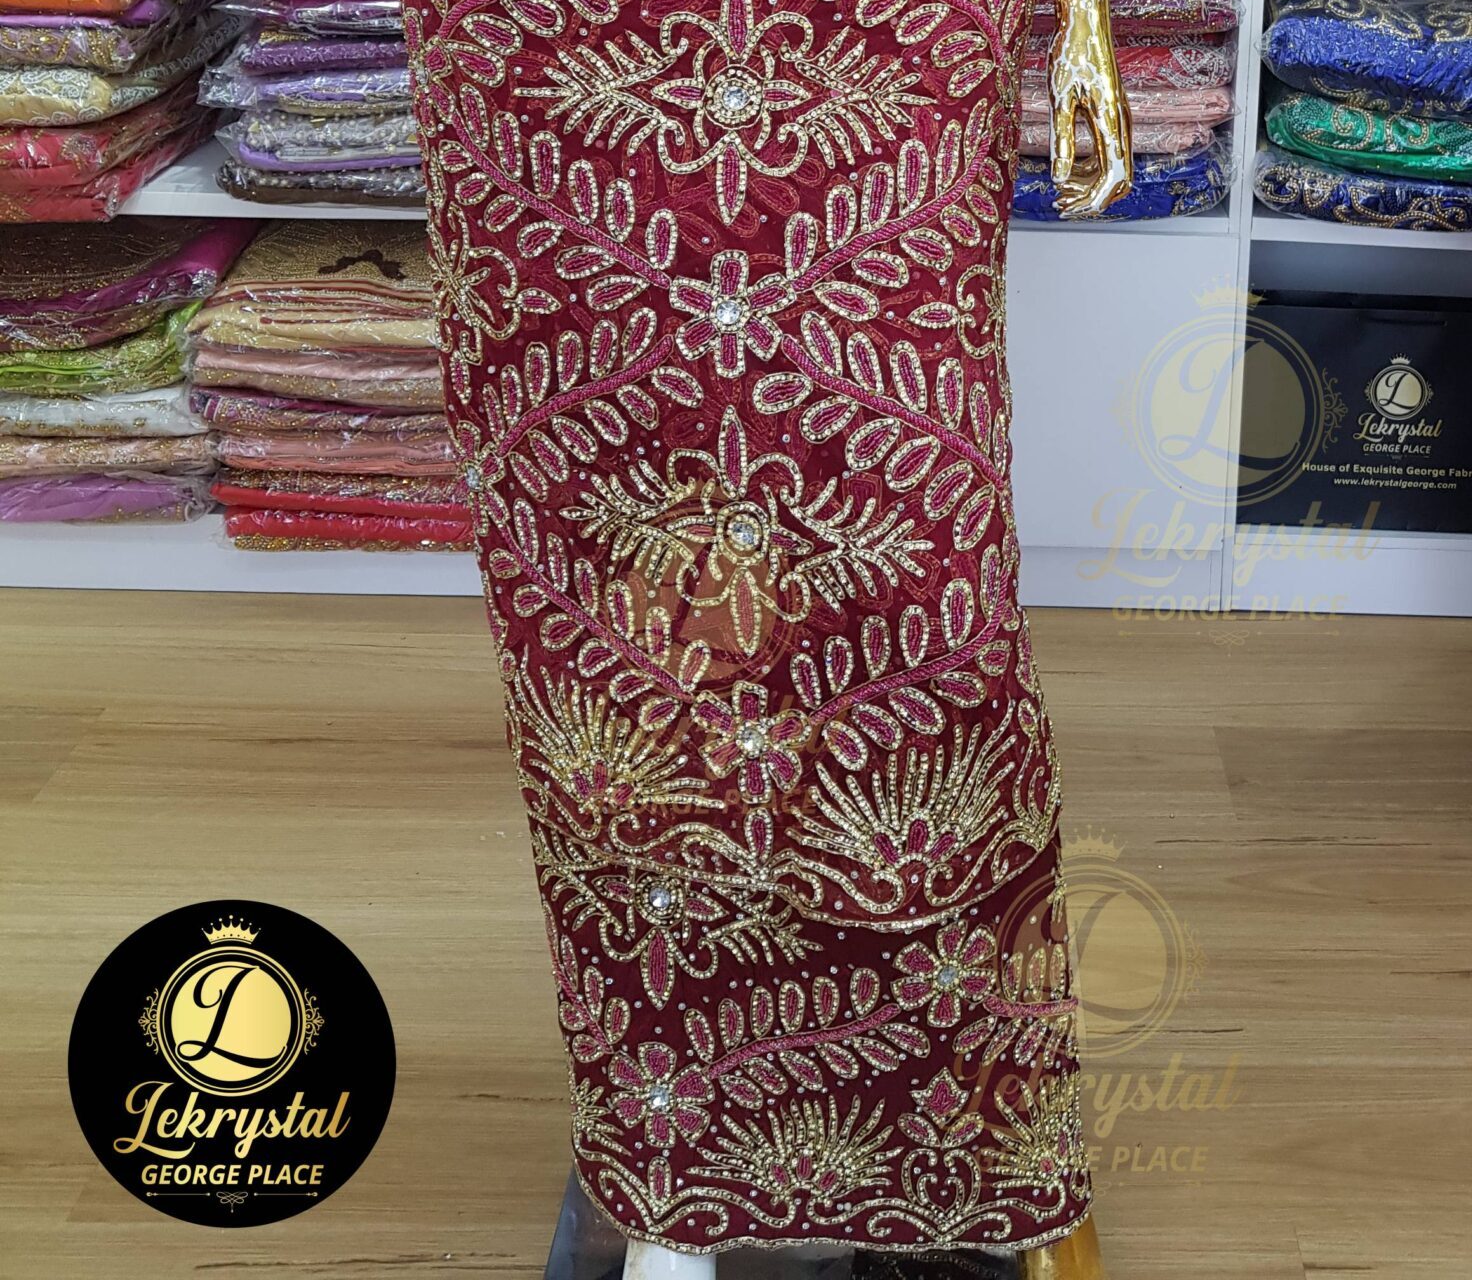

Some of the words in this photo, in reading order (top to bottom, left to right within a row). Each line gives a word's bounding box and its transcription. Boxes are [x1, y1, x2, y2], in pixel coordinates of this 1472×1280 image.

[1353, 412, 1442, 442] Lekrystal
[1362, 443, 1401, 453] GEORGE
[1402, 444, 1432, 454] PLACE
[1302, 462, 1336, 473] House
[1339, 463, 1350, 473] of
[1353, 464, 1403, 475] Exquisite
[1406, 466, 1446, 477] George
[1333, 477, 1457, 490] www.lekrystalgeorge.com
